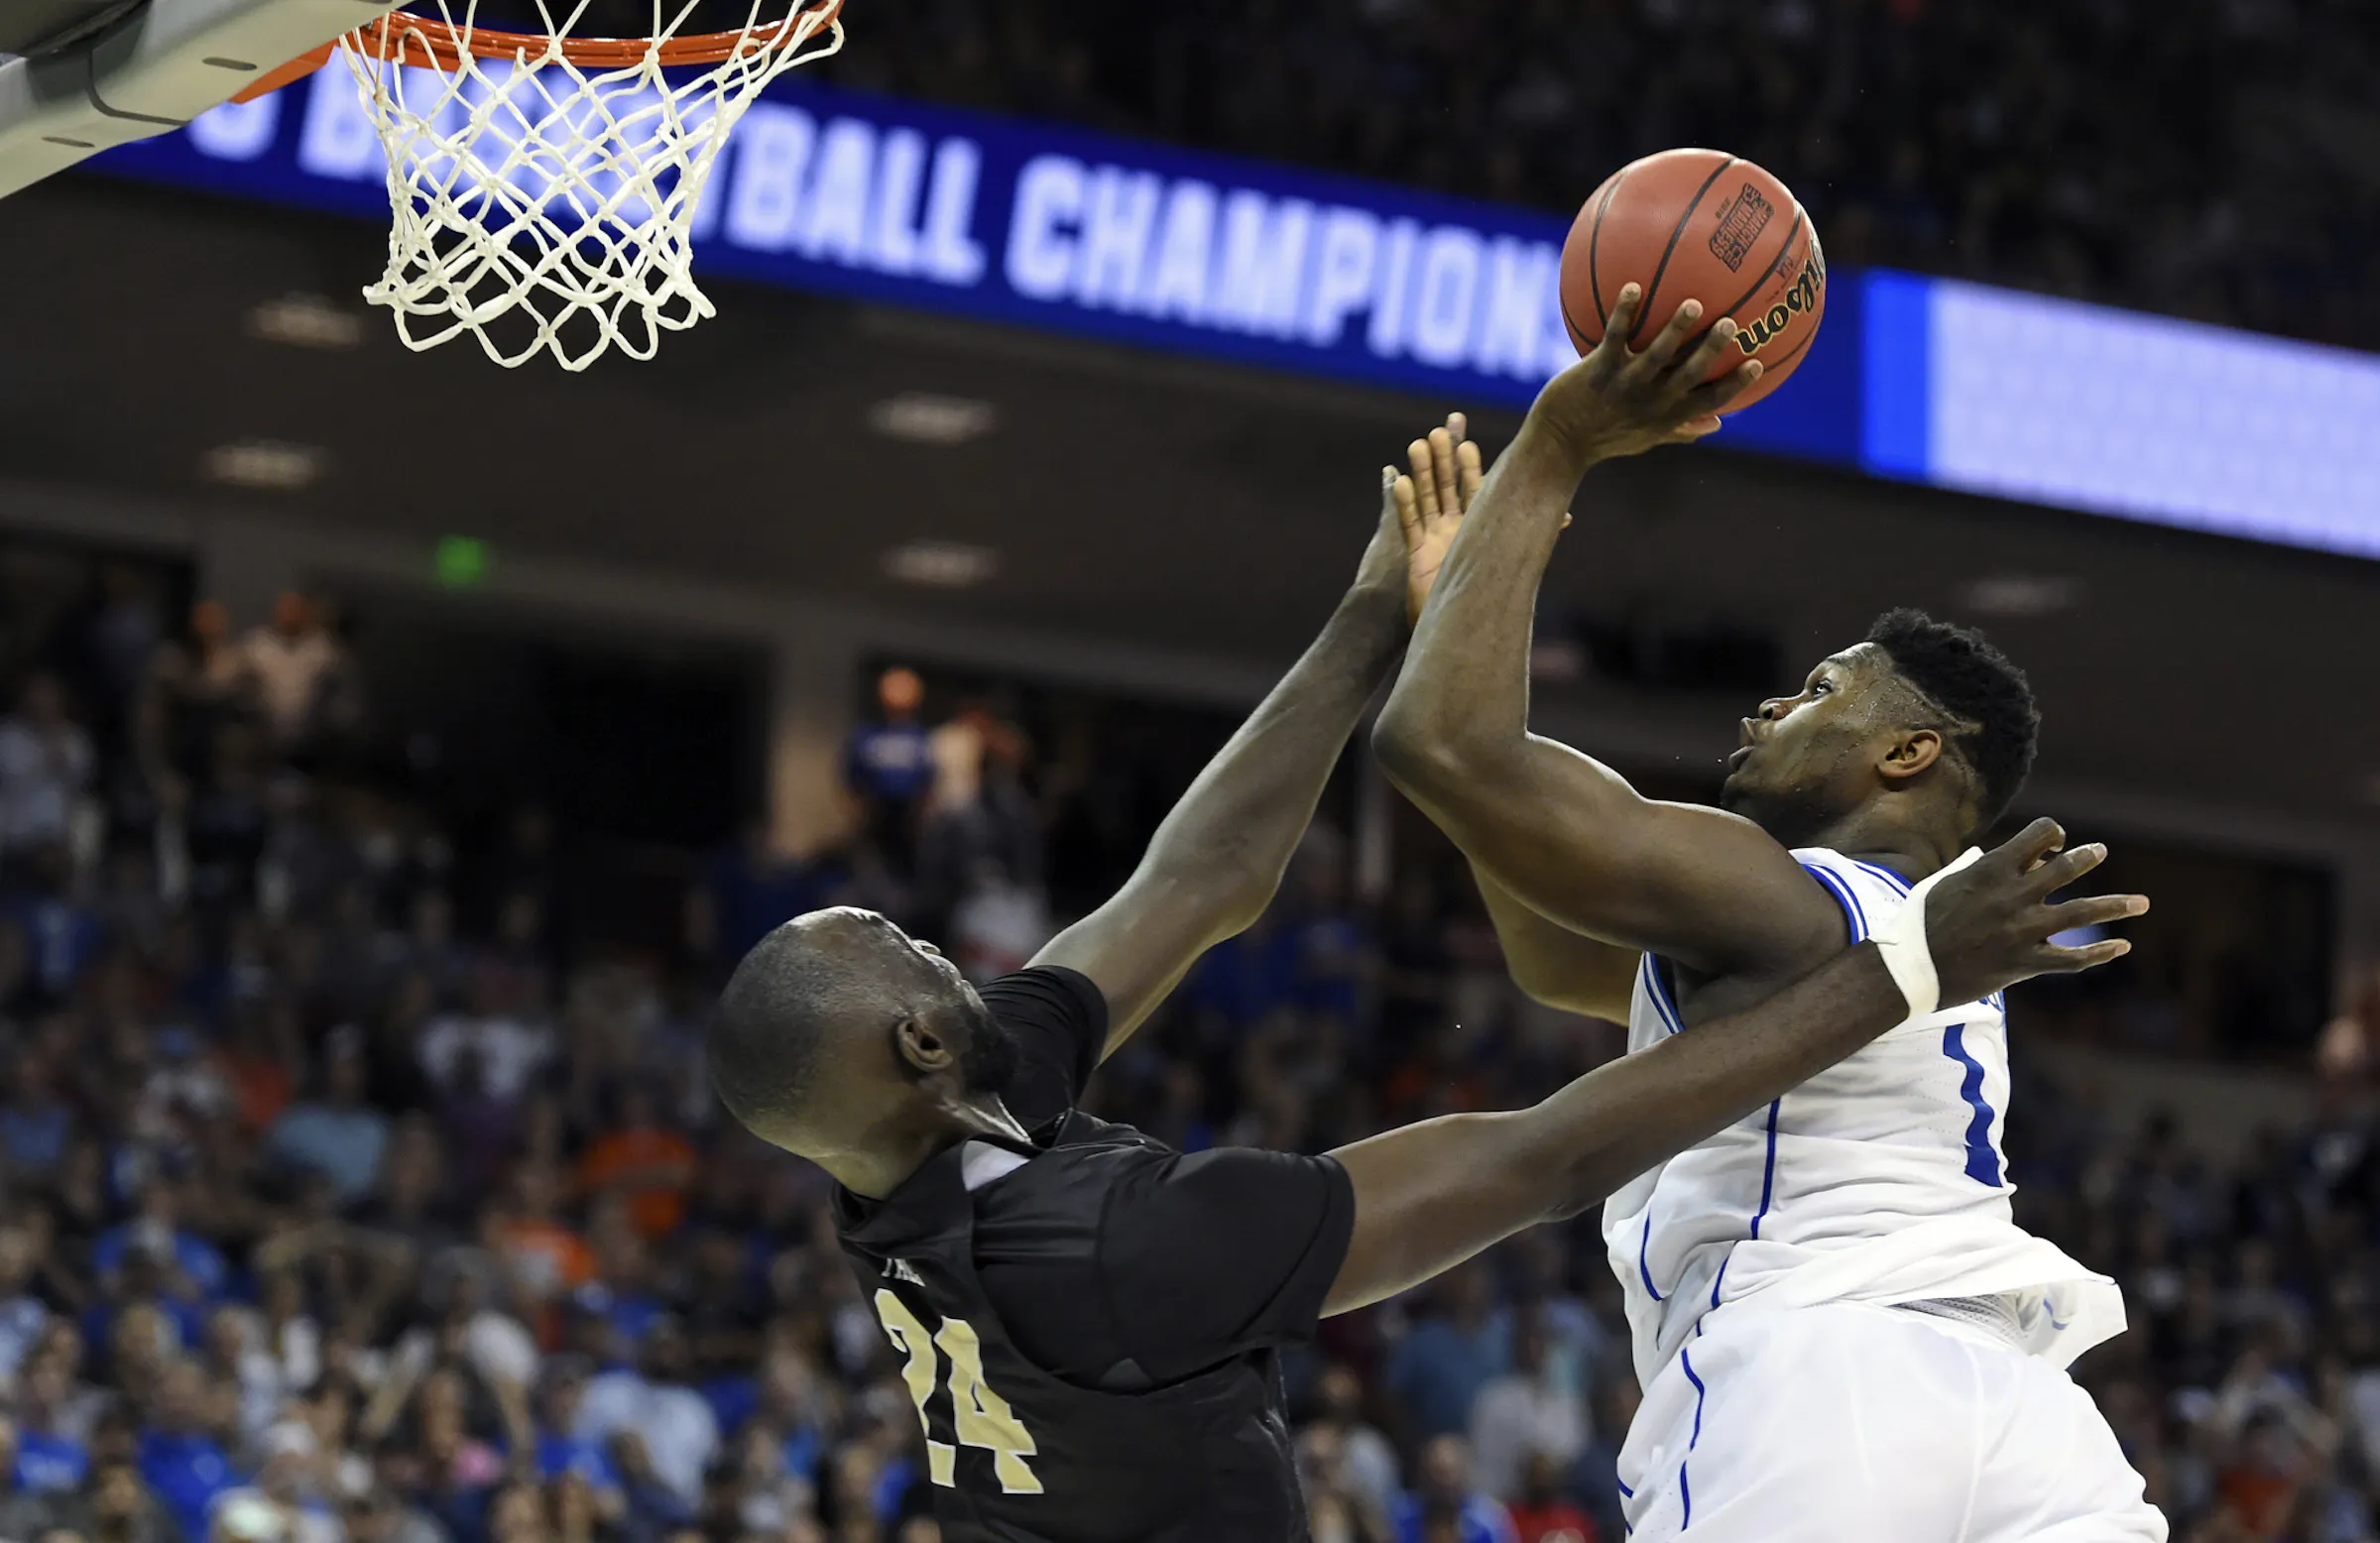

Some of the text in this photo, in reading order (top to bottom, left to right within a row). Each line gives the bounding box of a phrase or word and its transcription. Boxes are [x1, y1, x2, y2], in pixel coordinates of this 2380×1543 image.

[1005, 154, 1582, 383] CHAMPION
[1943, 1022, 2003, 1188] 1
[874, 1287, 1044, 1493] 24
